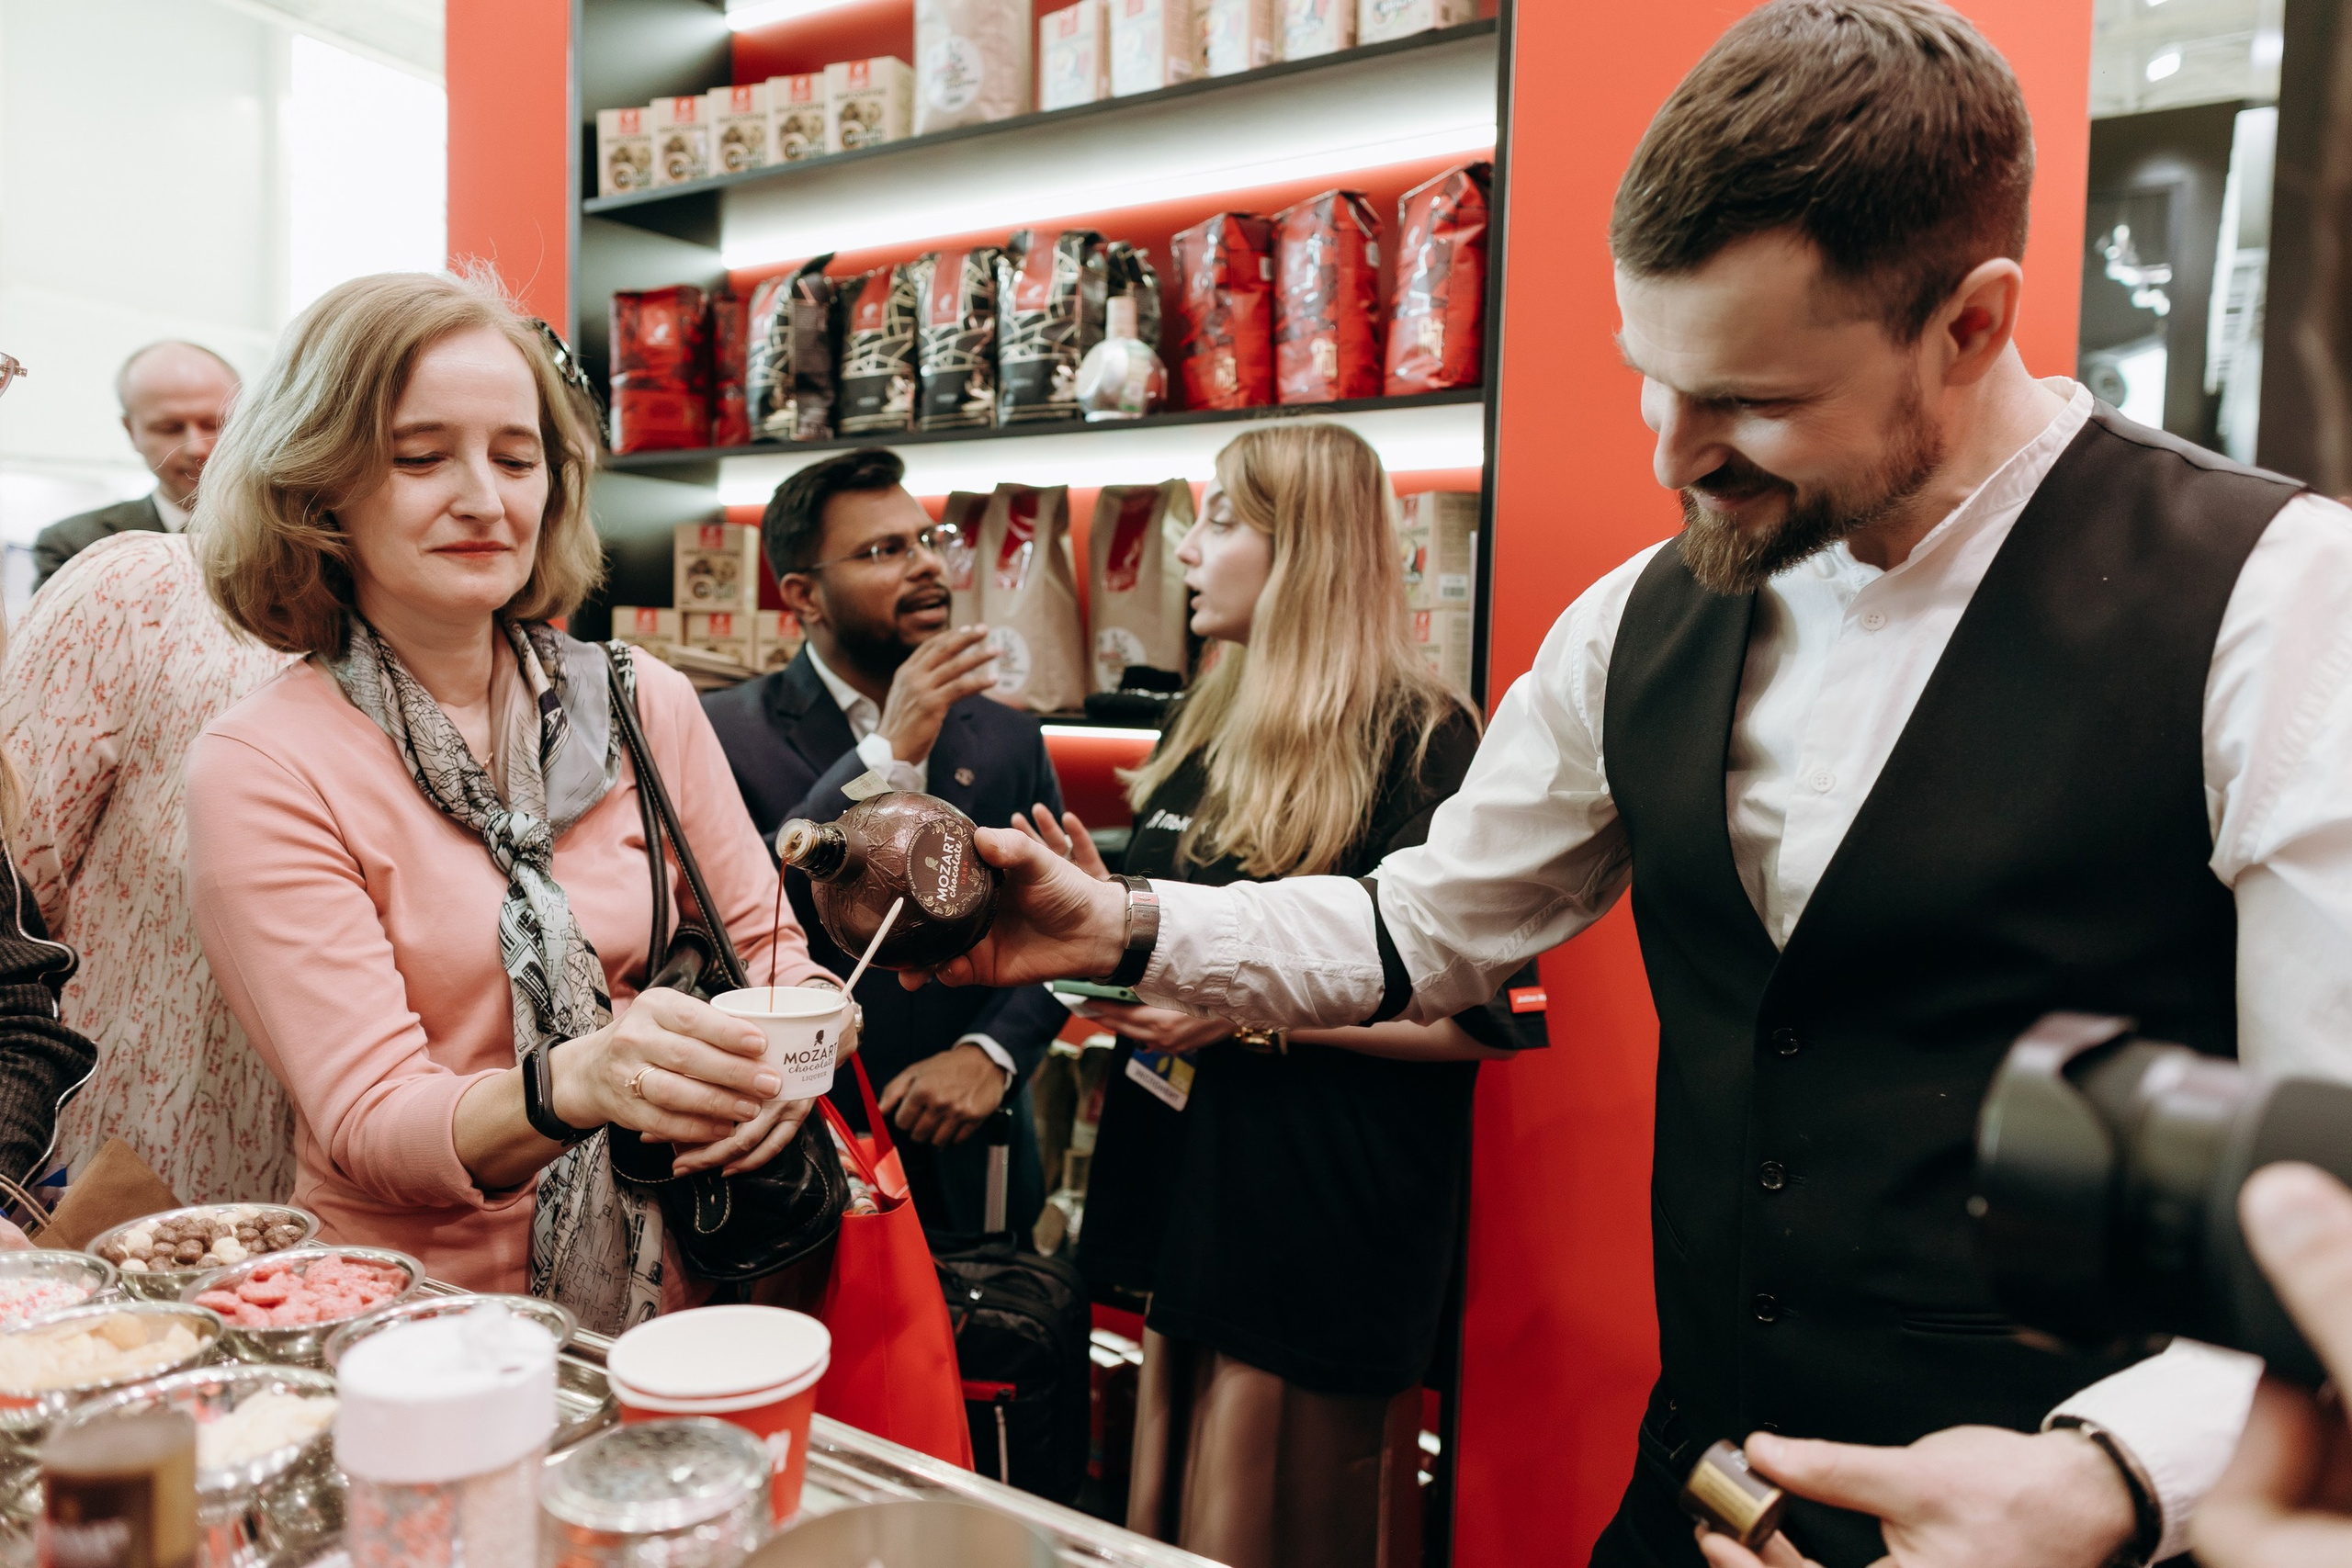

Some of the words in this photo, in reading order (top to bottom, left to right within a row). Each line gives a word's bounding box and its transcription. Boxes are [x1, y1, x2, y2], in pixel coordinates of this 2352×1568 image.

[936, 832, 956, 902] MOZART
[948, 840, 963, 898] chocolate
[960, 861, 969, 885] DARK
[784, 1042, 838, 1065] MOZART
[788, 1057, 834, 1074] chocolate
[802, 1071, 827, 1082] LIQUEUR
